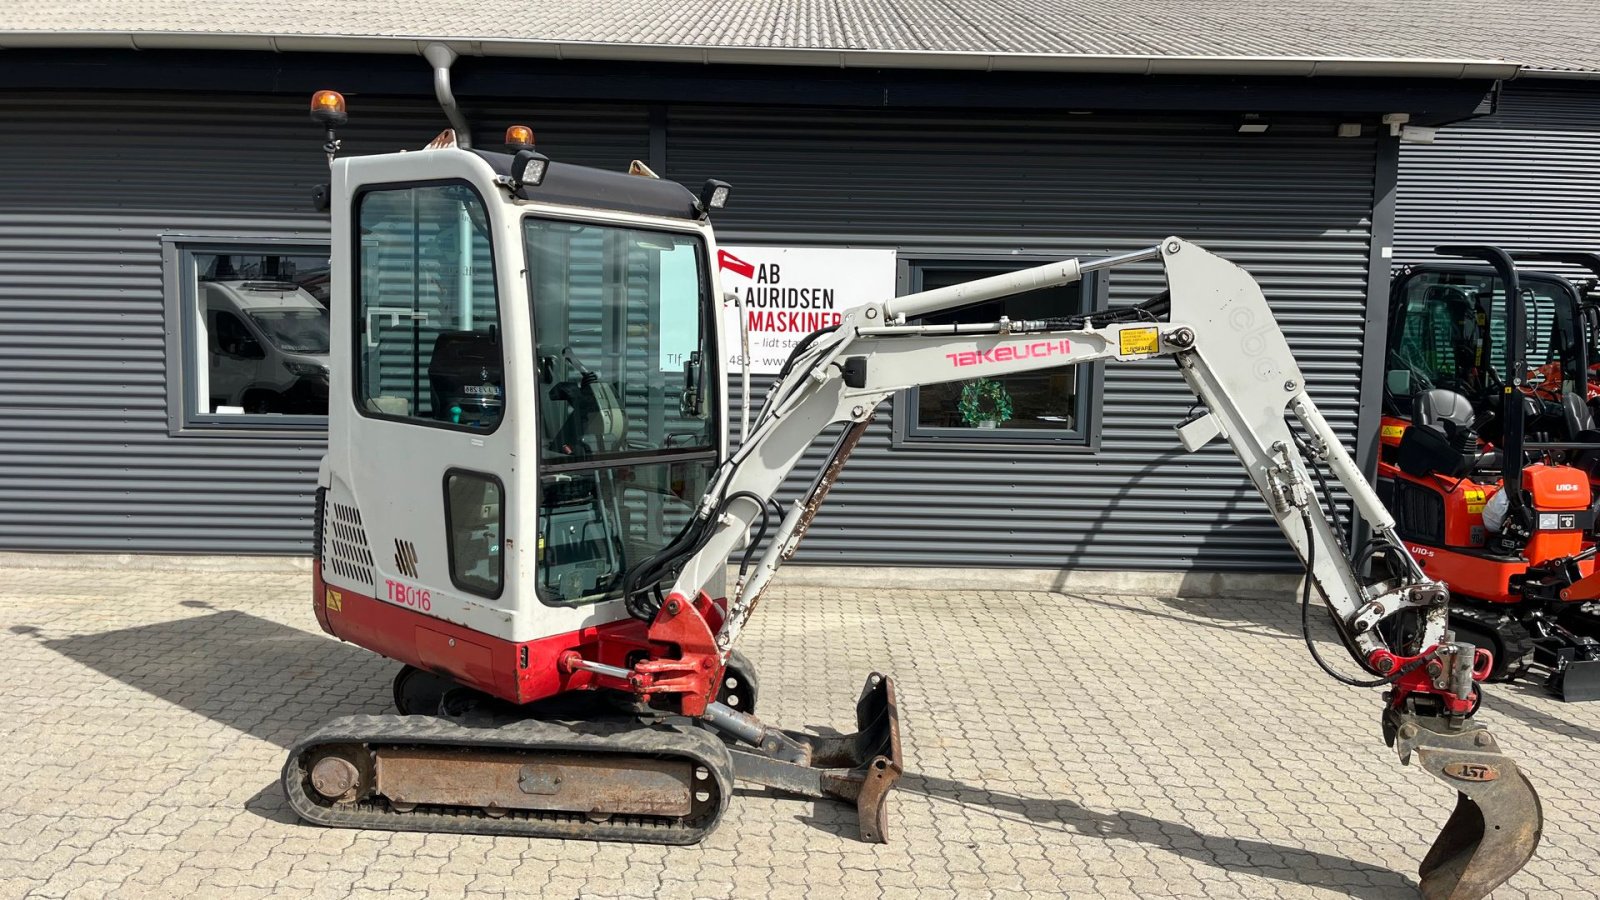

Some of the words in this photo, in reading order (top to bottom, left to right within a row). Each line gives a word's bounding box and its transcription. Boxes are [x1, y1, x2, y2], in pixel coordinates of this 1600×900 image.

[757, 263, 780, 284] AB
[762, 338, 779, 348] lidt
[946, 340, 1070, 367] TAKEUCHI
[385, 579, 431, 612] TB016
